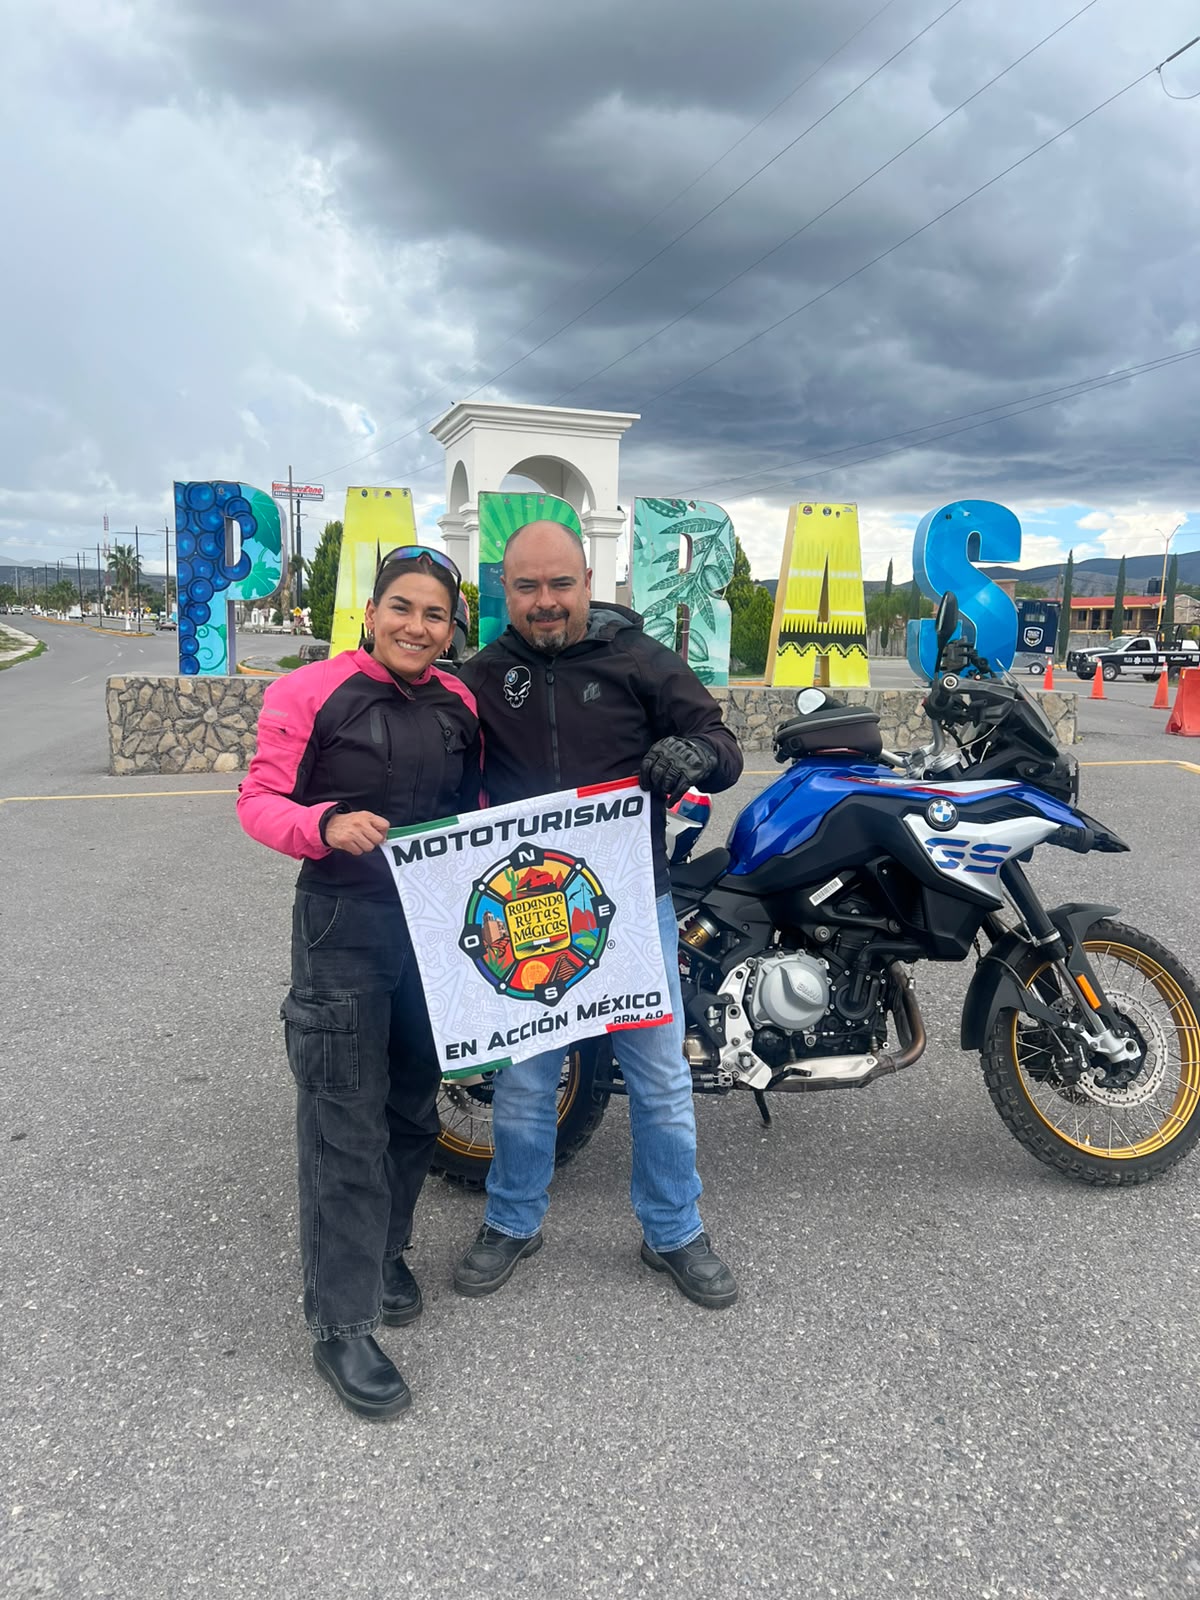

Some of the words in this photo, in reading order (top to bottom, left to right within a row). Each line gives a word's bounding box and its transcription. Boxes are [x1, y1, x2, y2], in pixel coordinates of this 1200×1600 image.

[391, 796, 644, 867] MOTOTURISMO
[518, 849, 536, 862] N
[925, 837, 1012, 875] GS
[598, 904, 611, 916] E
[544, 987, 559, 999] S
[613, 1014, 640, 1024] RRM
[645, 1010, 664, 1020] 4.0
[445, 1038, 477, 1061] EN
[487, 1012, 568, 1051] ACCIÓN
[576, 991, 661, 1021] MÉXICO
